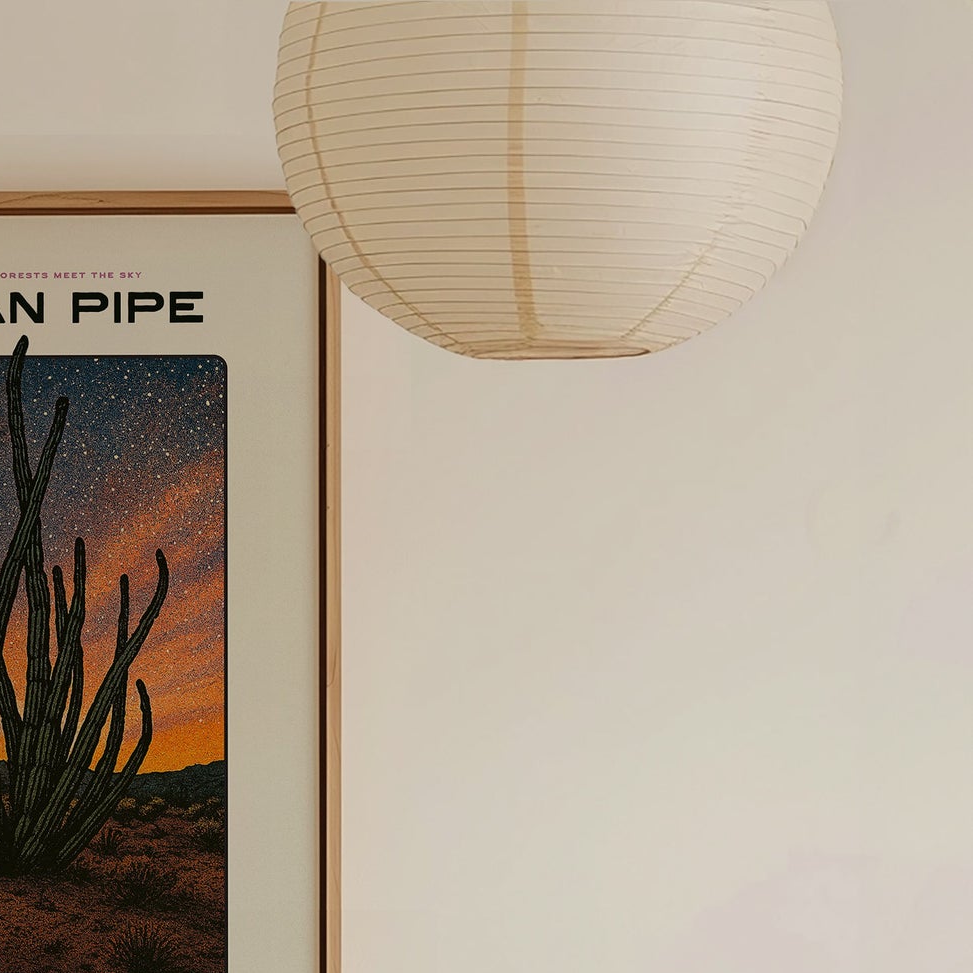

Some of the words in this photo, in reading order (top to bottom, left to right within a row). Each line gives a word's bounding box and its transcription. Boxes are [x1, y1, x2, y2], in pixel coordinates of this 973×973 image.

[53, 271, 87, 279] MEET
[90, 271, 115, 279] THE
[119, 271, 142, 279] SKY
[72, 291, 204, 324] PIPE
